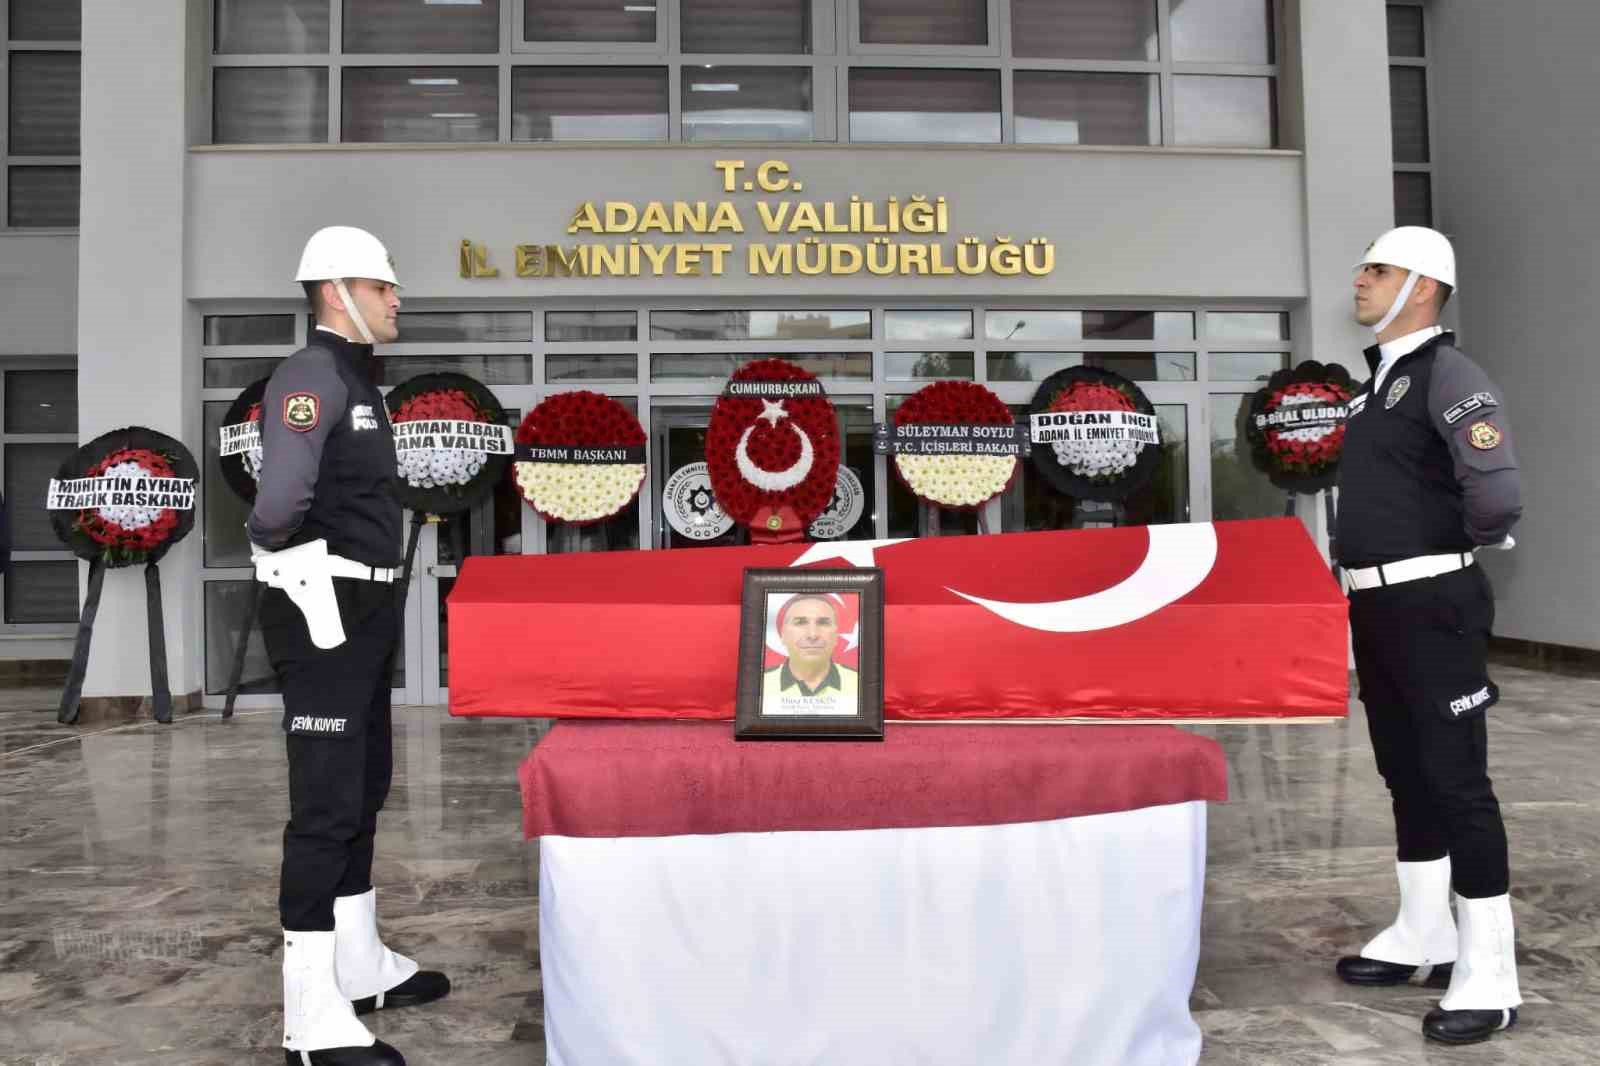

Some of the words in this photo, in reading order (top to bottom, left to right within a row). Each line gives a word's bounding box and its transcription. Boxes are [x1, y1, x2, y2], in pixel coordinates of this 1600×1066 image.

[715, 159, 802, 192] T.C.
[567, 200, 744, 234] ADANA
[756, 194, 948, 234] VALİLİĞİ
[459, 239, 499, 278] İL
[514, 238, 732, 277] EMNİYET
[748, 235, 1056, 276] MÜDÜRLÜĞÜ
[730, 383, 820, 397] CUMHURBAŞKANI
[1038, 412, 1112, 427] DOĞAN
[896, 424, 969, 439] SÜLEYMAN
[972, 426, 1015, 439] SOYLU
[530, 448, 568, 460] TBMM
[573, 449, 627, 462] BAŞKANI
[976, 443, 1020, 454] BAKANI
[136, 478, 193, 494] AYHAN
